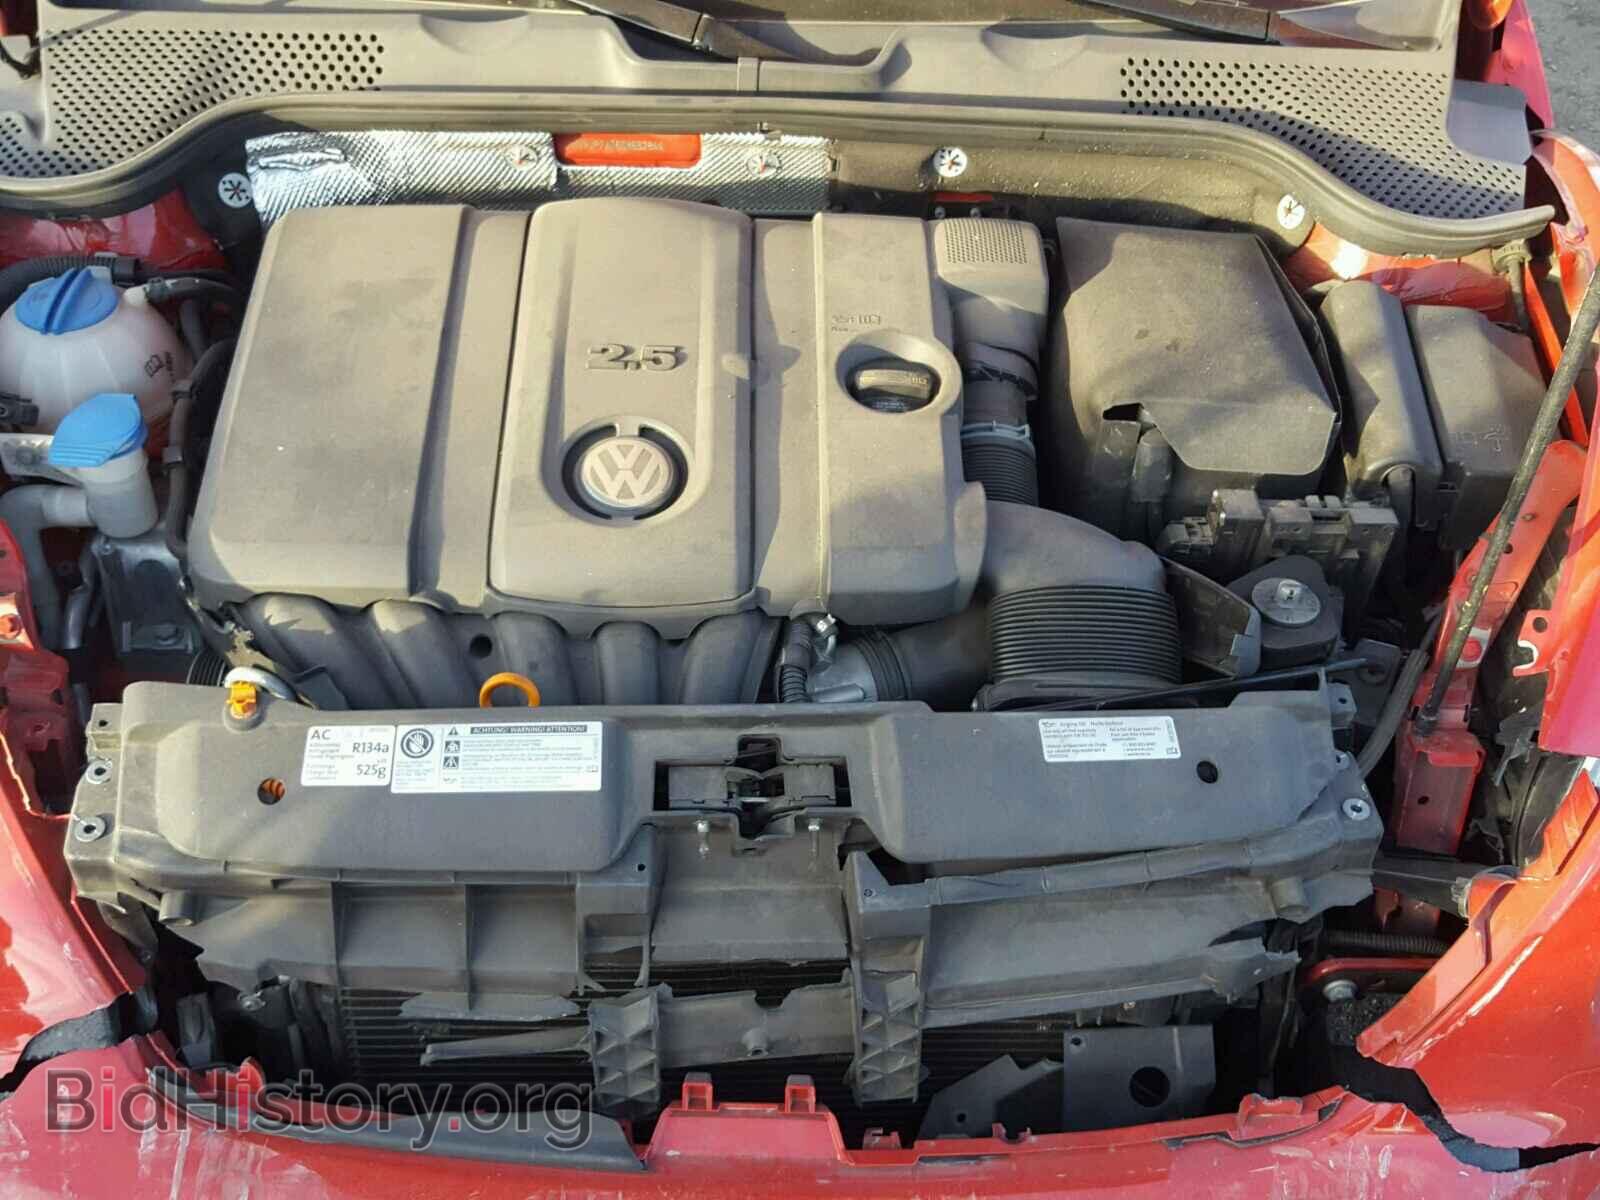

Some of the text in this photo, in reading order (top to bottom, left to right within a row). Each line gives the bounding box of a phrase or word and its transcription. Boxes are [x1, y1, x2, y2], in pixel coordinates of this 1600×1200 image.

[585, 343, 682, 372] 2.5
[584, 440, 668, 505] VW
[310, 729, 332, 741] AC
[546, 725, 586, 733] ATTENTION!
[352, 741, 390, 754] R134a
[356, 763, 386, 780] 525g
